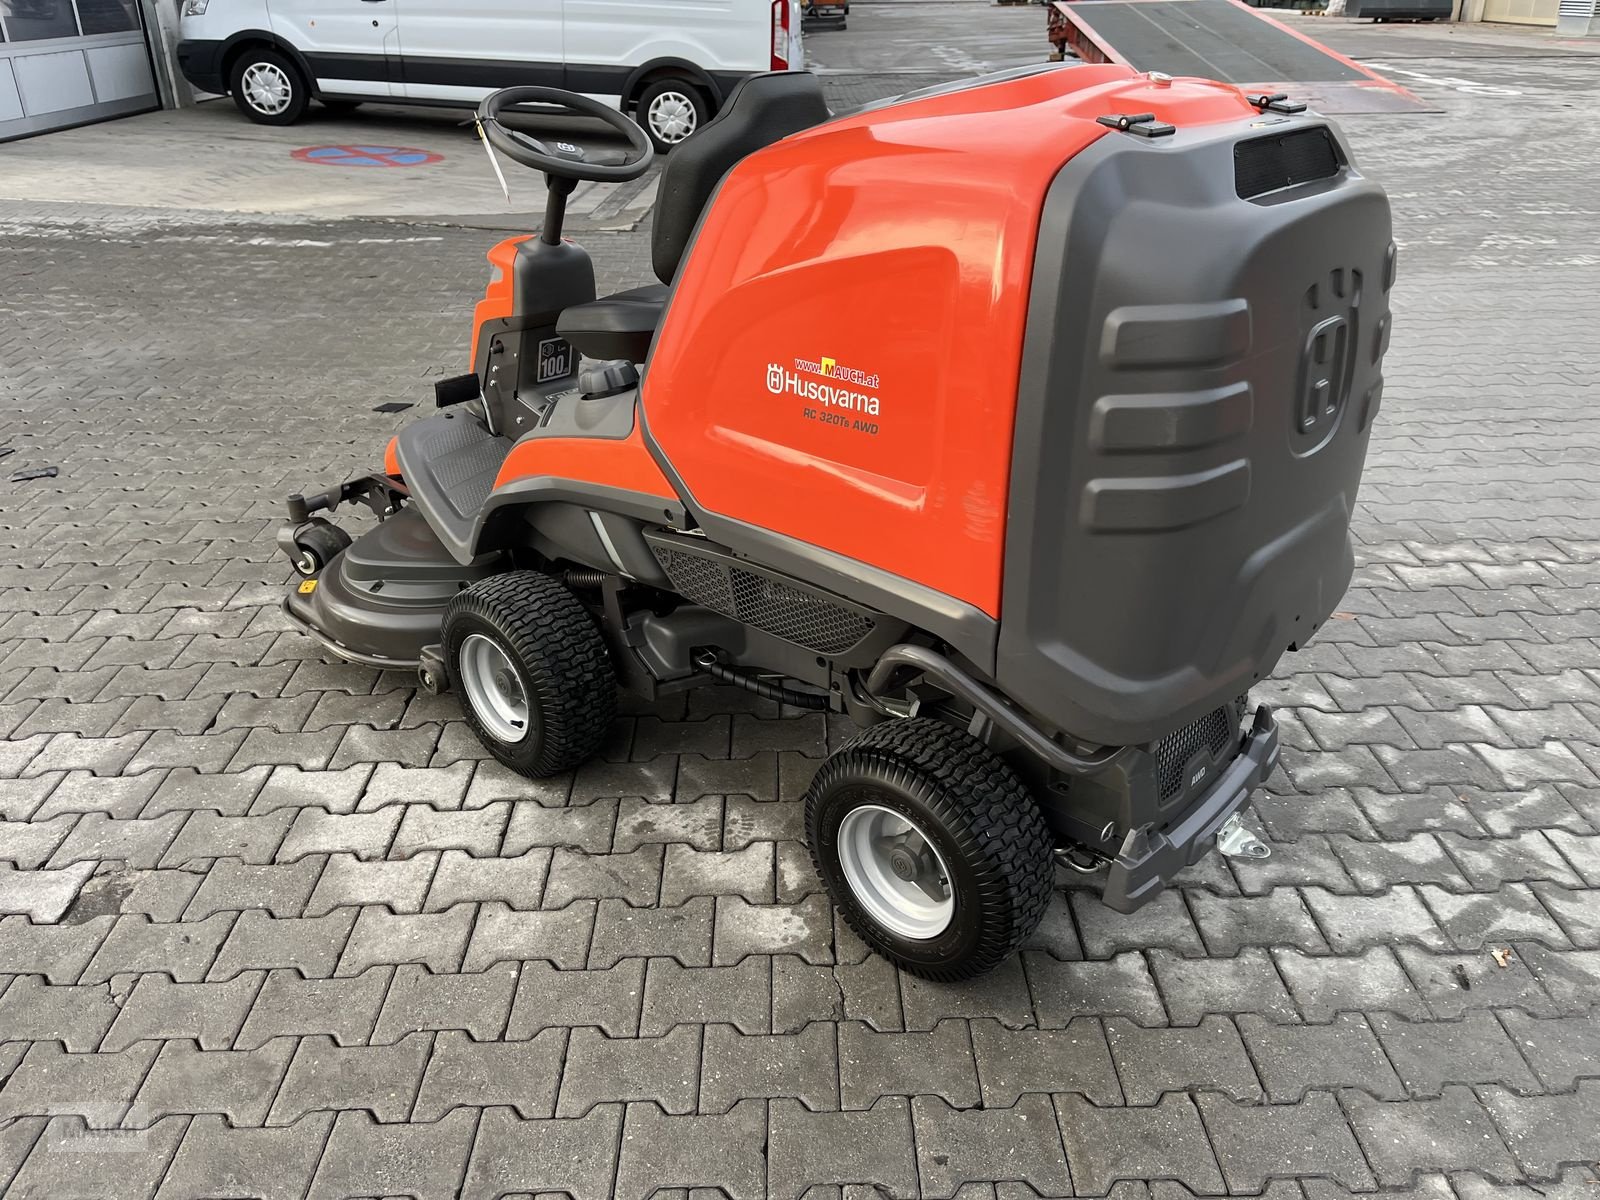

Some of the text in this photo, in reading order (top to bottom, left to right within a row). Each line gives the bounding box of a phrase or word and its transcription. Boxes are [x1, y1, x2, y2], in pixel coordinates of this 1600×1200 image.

[542, 354, 565, 378] 100
[785, 371, 880, 415] Husqvarna
[803, 407, 817, 419] RC
[852, 419, 879, 435] AWD
[1191, 766, 1206, 786] AWD
